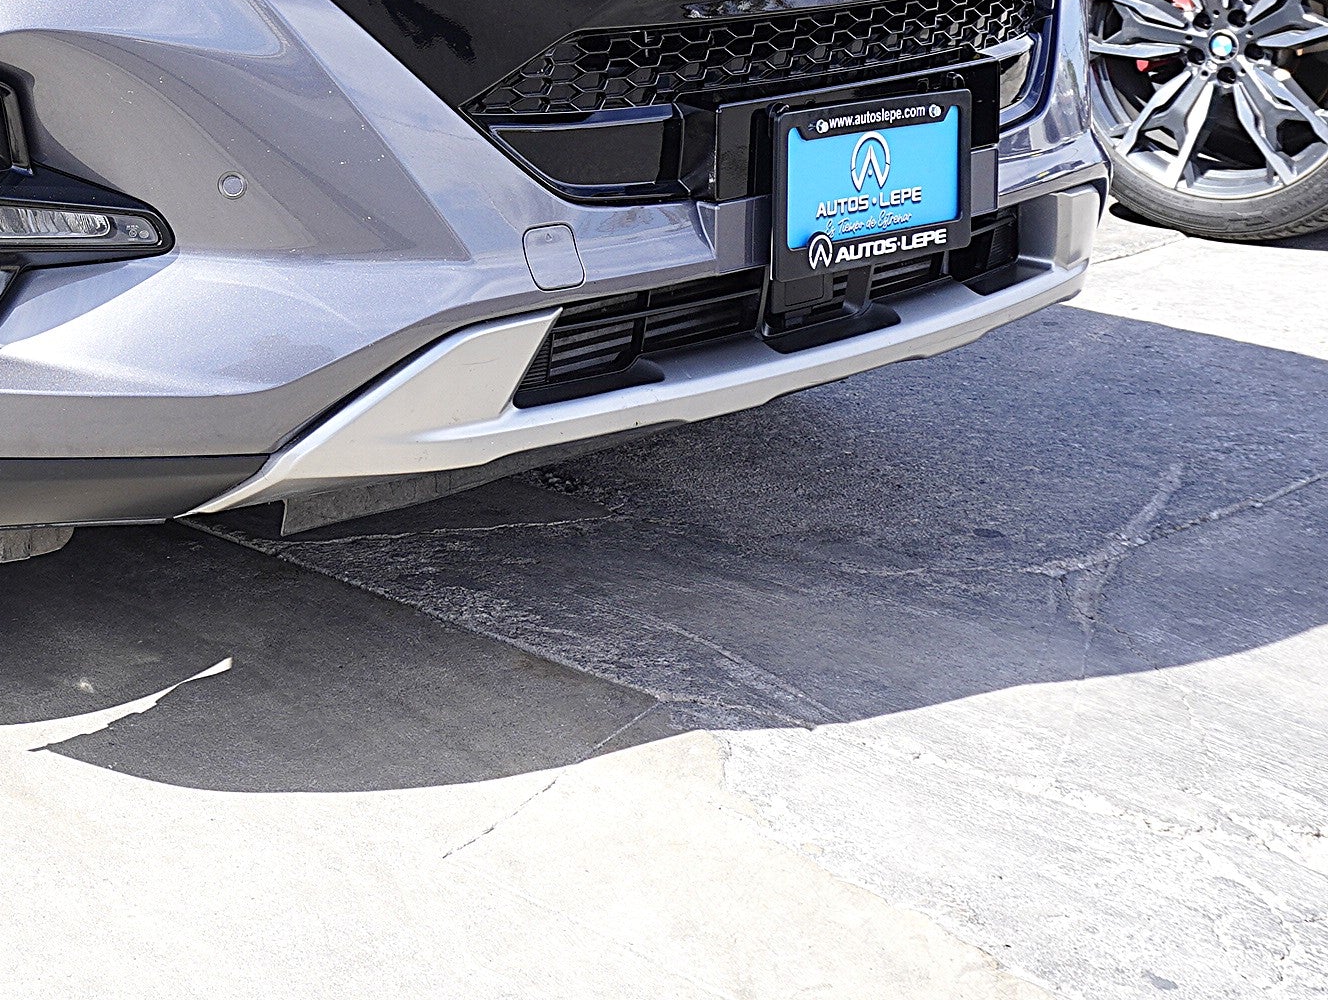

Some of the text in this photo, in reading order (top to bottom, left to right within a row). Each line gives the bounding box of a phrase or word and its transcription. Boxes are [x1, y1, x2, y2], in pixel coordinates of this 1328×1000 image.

[829, 105, 926, 129] www.autoslepe.com
[837, 216, 865, 236] Tiempo
[865, 216, 876, 230] de
[877, 208, 913, 232] Estrenar
